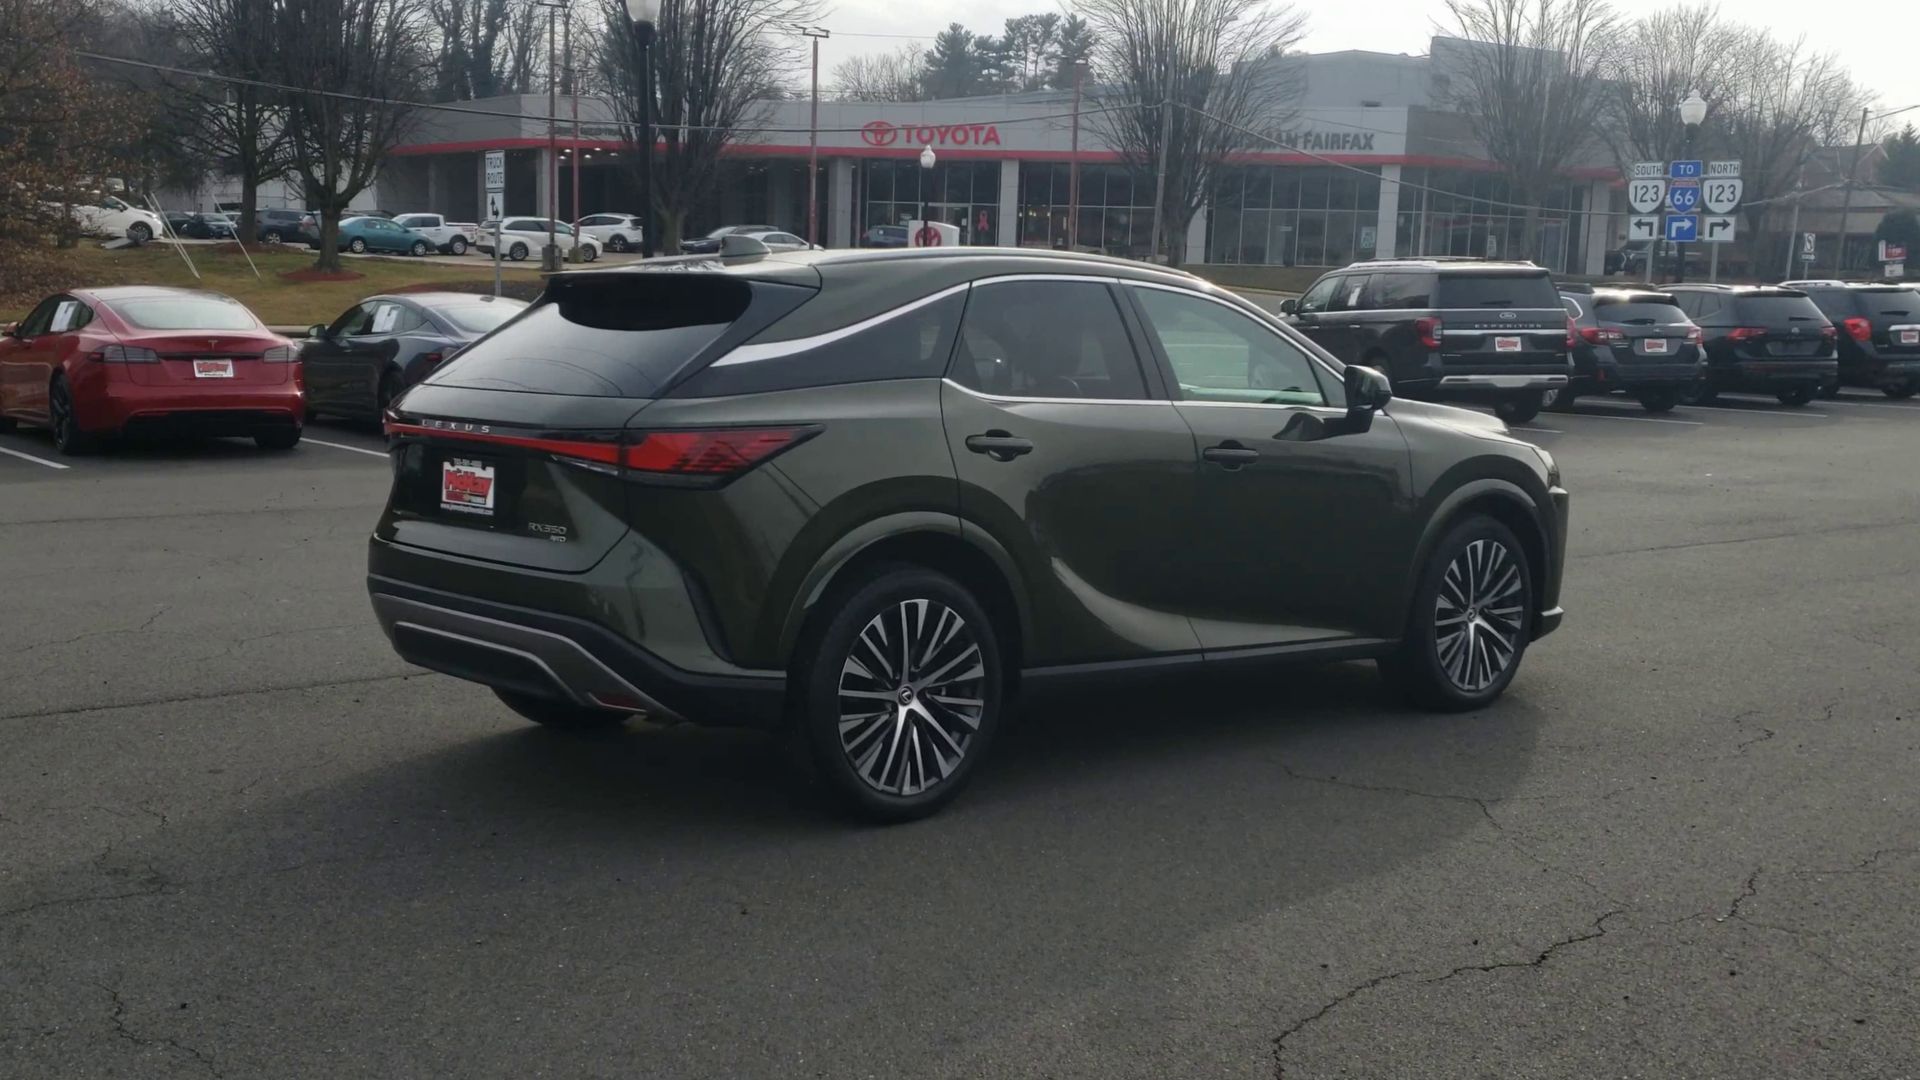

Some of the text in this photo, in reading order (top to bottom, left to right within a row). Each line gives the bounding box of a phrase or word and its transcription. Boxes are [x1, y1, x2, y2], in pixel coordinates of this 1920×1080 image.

[902, 124, 1000, 145] TOYOTA
[1303, 131, 1374, 150] FAIRFAX
[1635, 165, 1662, 176] SOUTH
[1679, 164, 1694, 175] TO
[1710, 163, 1739, 174] NORTH
[1634, 184, 1659, 203] 123
[1674, 190, 1694, 205] 66
[1709, 184, 1736, 203] 123
[422, 419, 490, 433] LEXUS
